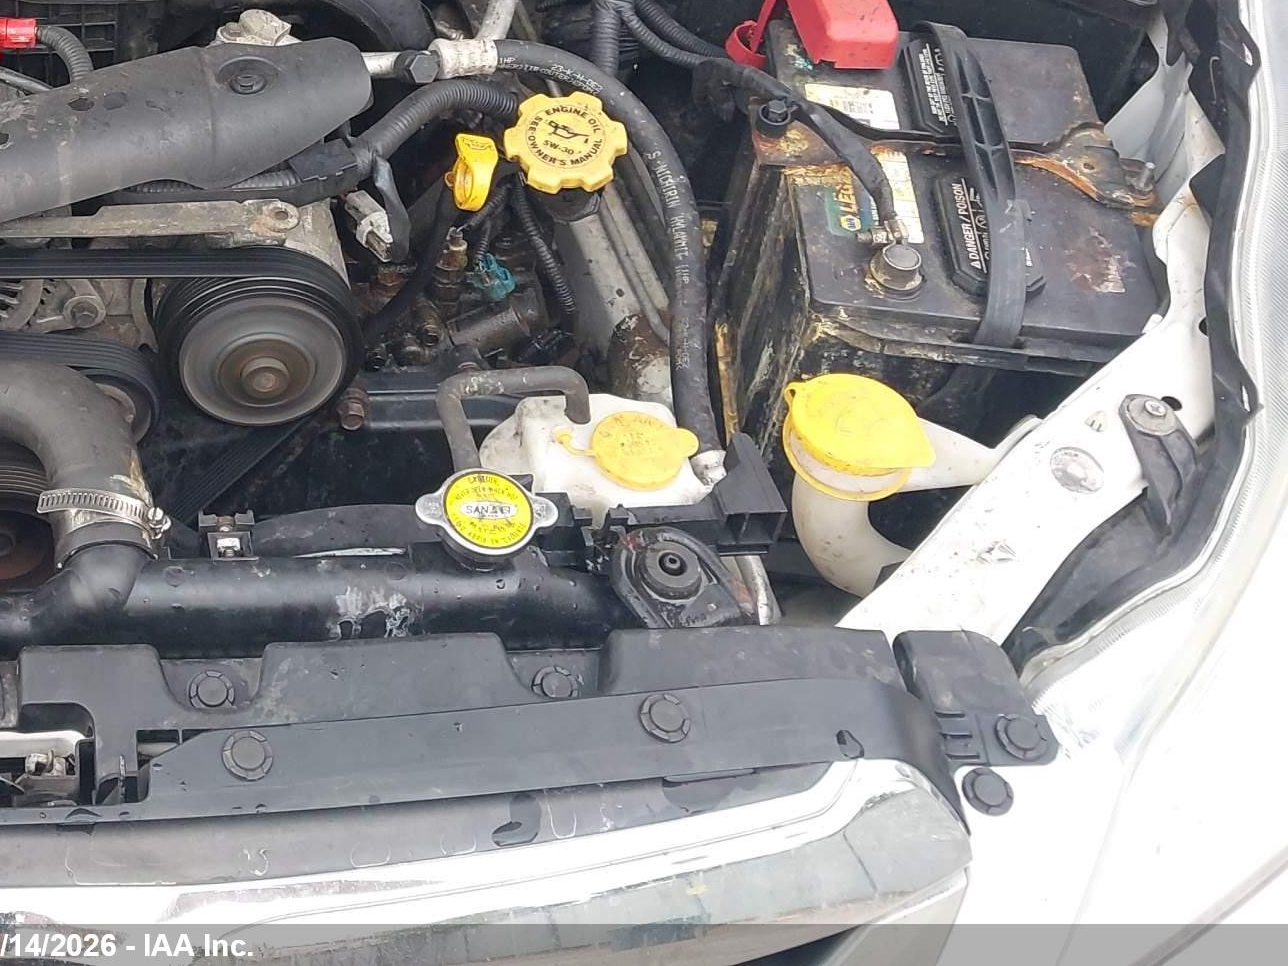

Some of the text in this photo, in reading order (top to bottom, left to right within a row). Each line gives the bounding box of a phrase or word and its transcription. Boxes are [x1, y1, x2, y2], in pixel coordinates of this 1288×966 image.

[544, 106, 602, 134] ENGINE OIL
[527, 115, 544, 132] SEE
[570, 138, 603, 165] MANUAL
[543, 139, 575, 155] 5W-30
[951, 183, 970, 215] POISON
[961, 222, 981, 261] DANGER
